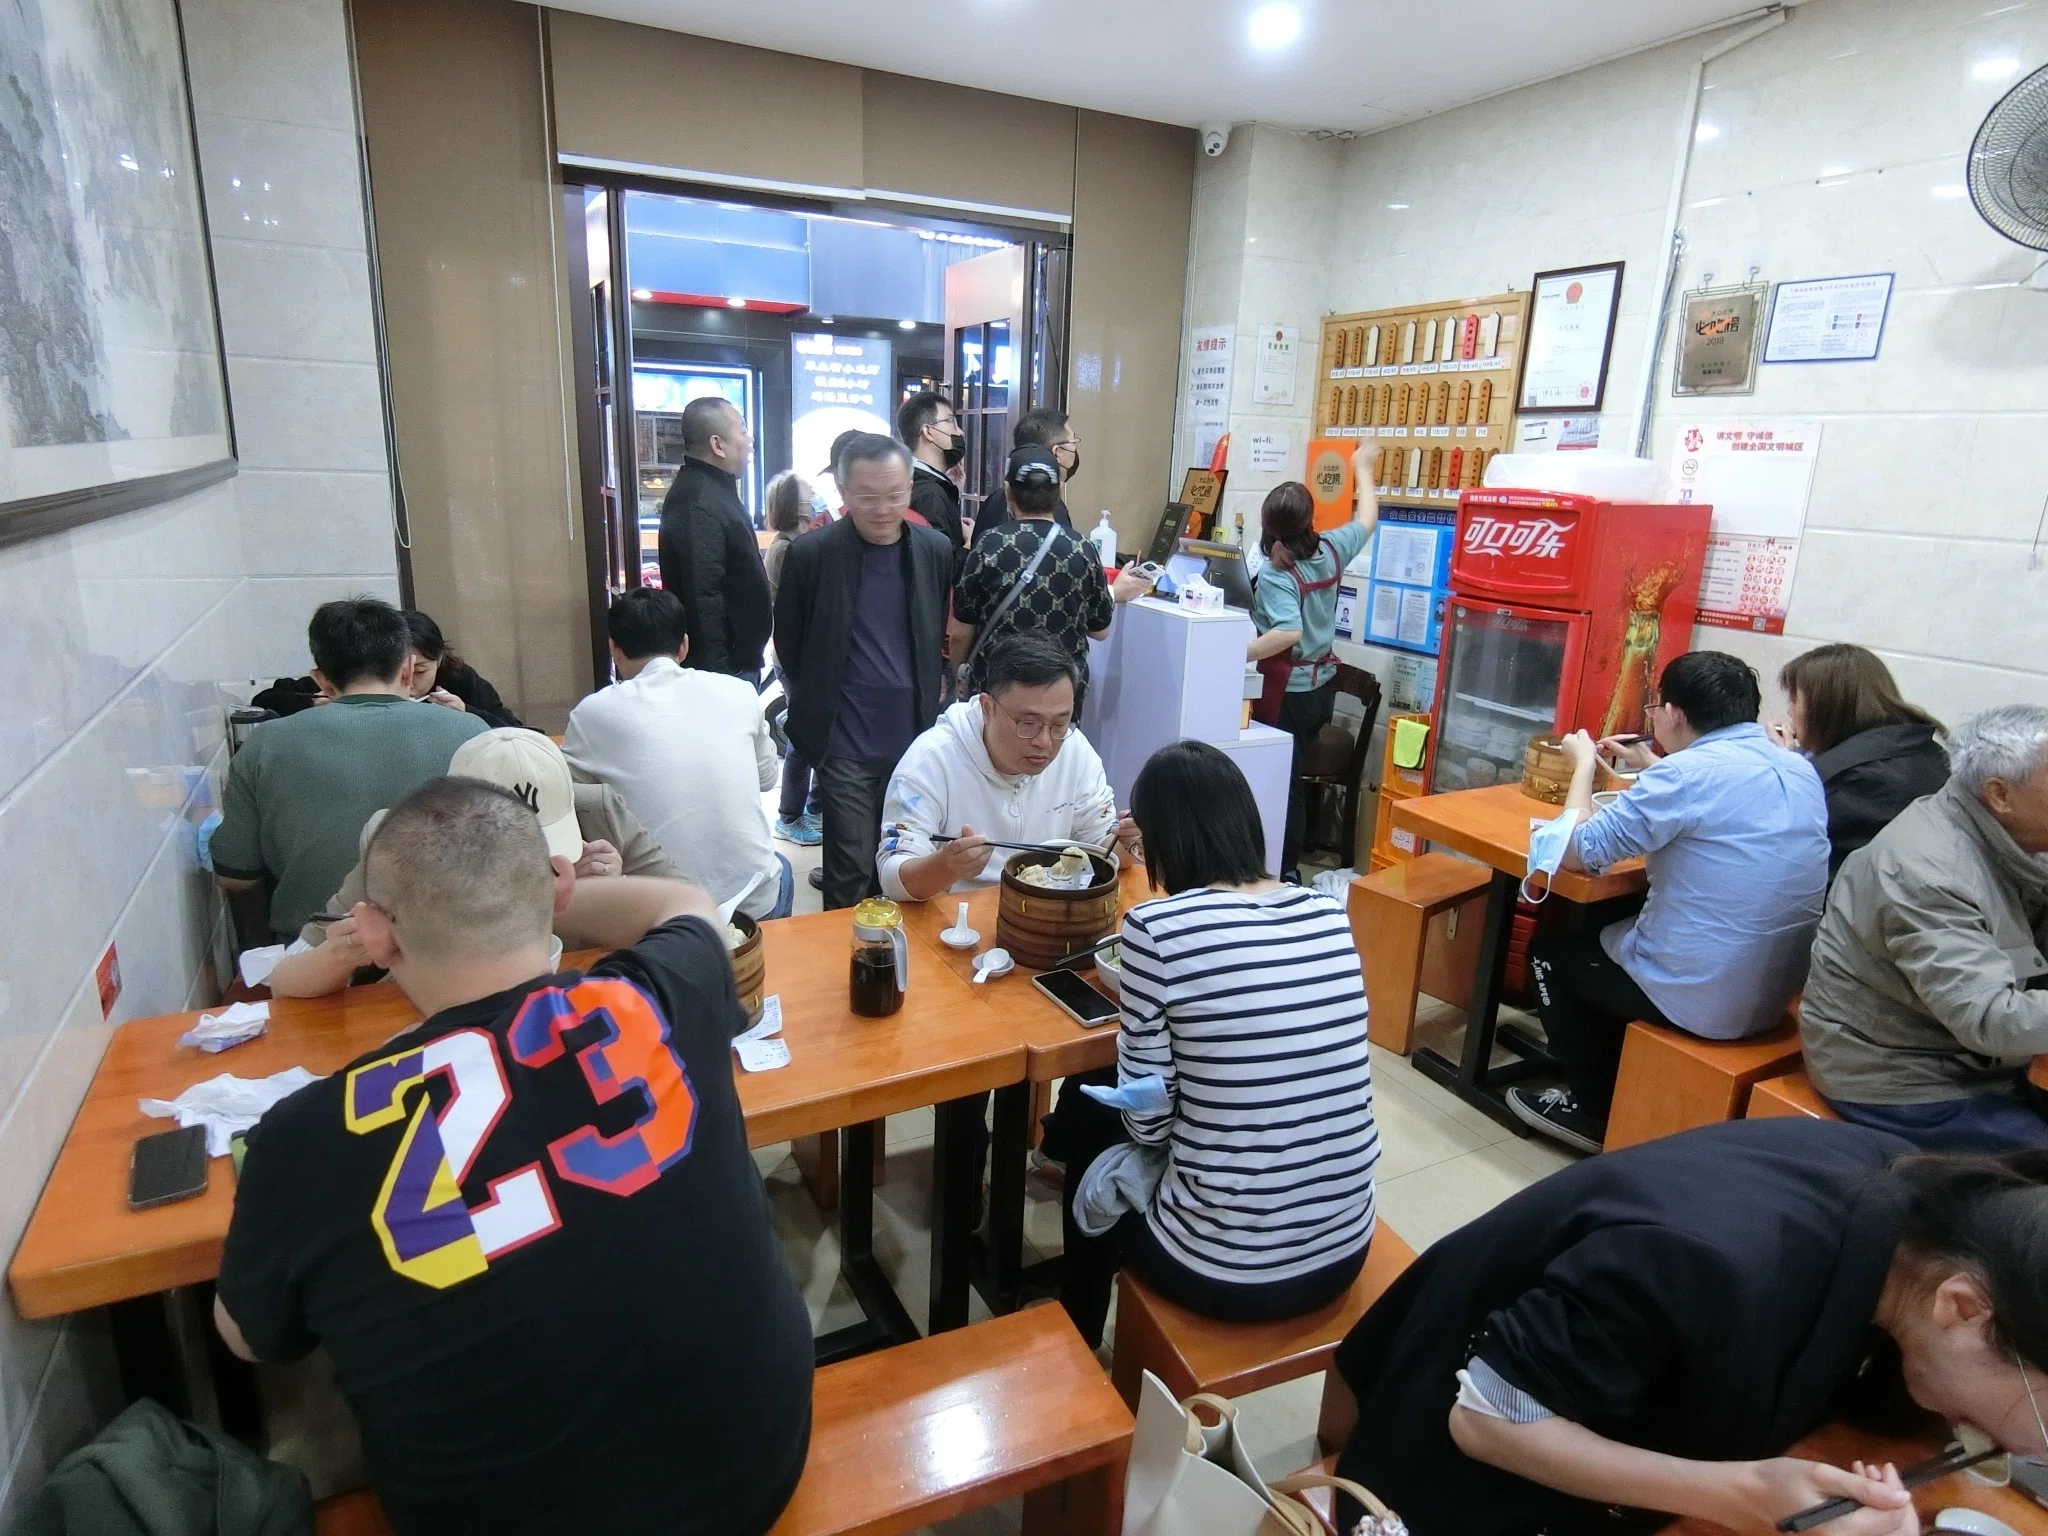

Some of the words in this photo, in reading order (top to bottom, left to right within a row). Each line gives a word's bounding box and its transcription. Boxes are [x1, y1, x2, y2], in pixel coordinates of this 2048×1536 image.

[1196, 337, 1227, 352] 友情提示
[1716, 431, 1743, 440] 讲文明
[1746, 431, 1774, 440] 守诚信
[1731, 442, 1804, 452] 创建全国文明城区
[1463, 516, 1577, 559] 可口可乐
[345, 976, 700, 1290] 23
